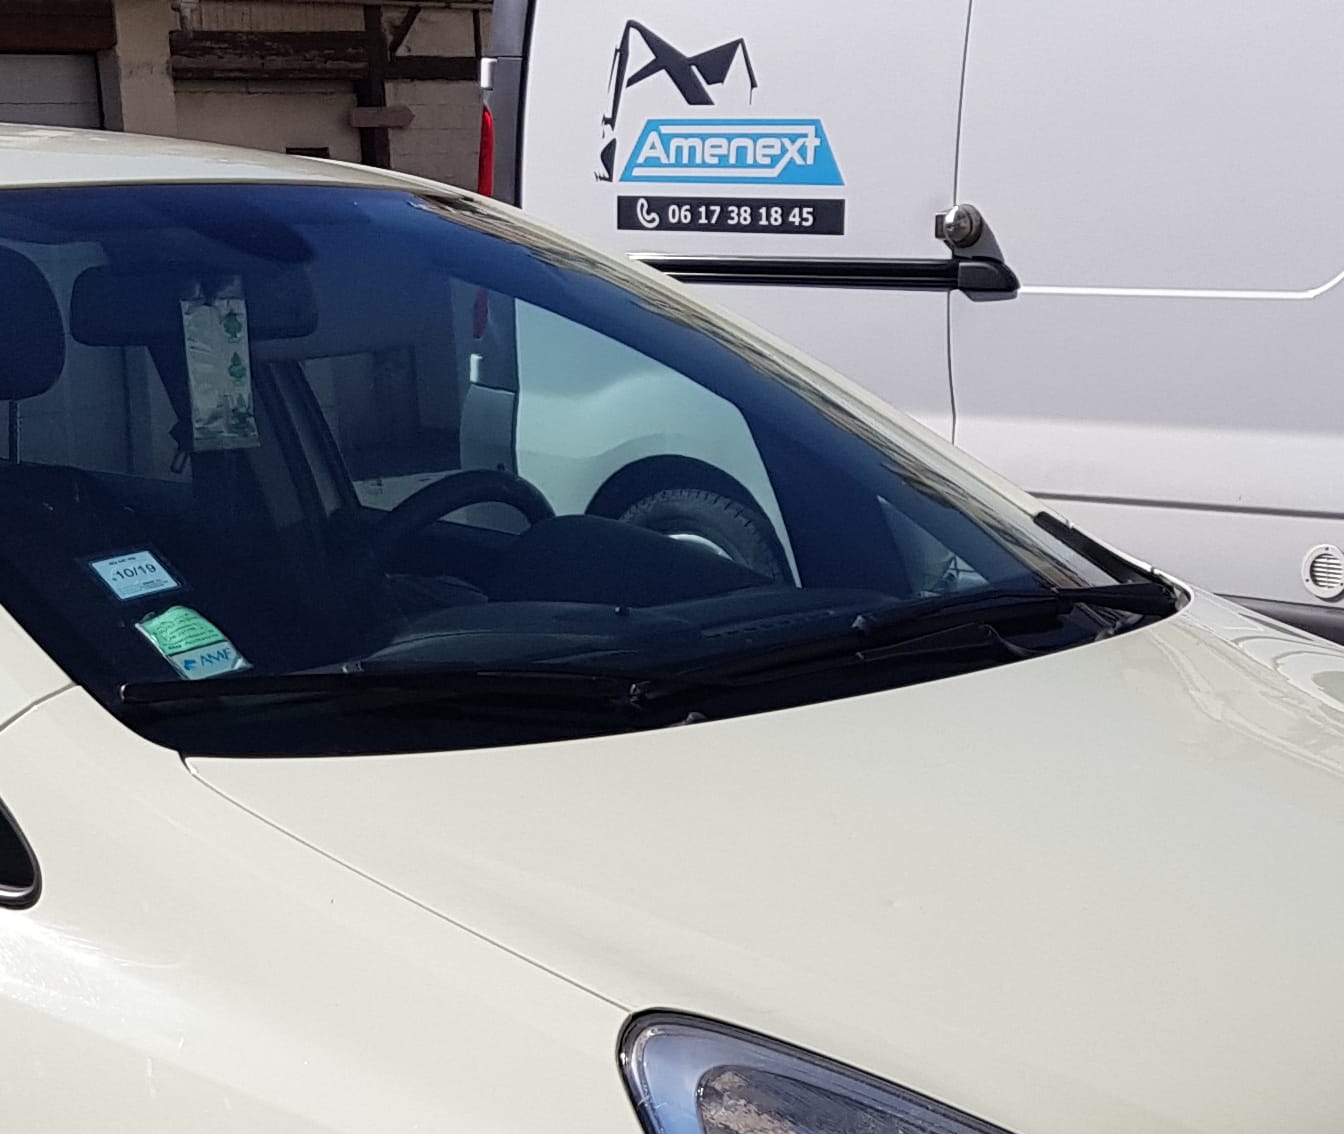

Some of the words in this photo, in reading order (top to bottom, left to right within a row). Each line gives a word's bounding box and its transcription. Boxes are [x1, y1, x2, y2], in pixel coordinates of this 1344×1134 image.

[637, 131, 821, 166] Amenext
[668, 205, 691, 224] 06
[698, 206, 721, 225] 17
[728, 206, 751, 225] 38
[758, 207, 782, 226] 18
[789, 207, 814, 227] 45
